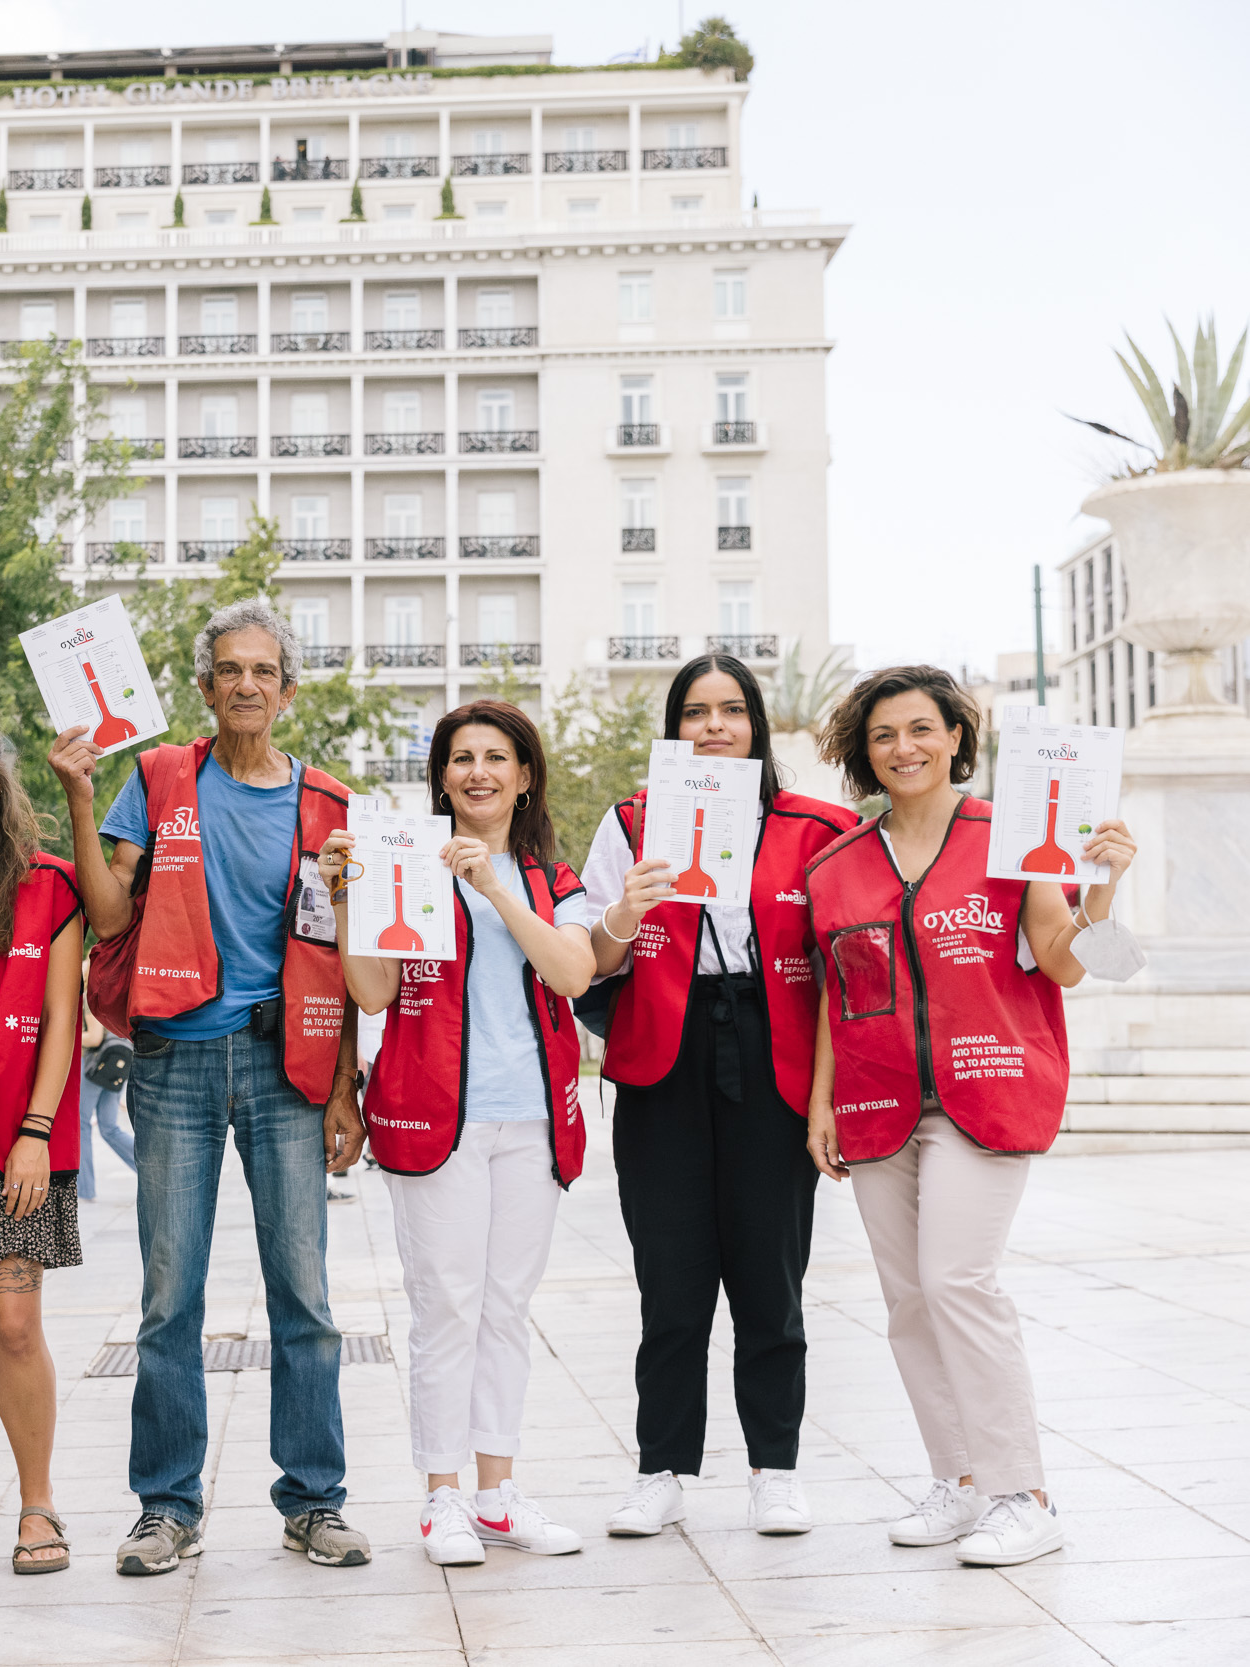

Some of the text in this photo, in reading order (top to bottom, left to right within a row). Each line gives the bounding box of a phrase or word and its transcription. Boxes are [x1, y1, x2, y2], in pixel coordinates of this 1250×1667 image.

[13, 73, 434, 108] HOTEL GRANDE BRETAGNE
[640, 924, 665, 933] HEDIA
[639, 932, 671, 943] REECE's
[932, 934, 966, 943] ΠΕΡΙΟΔΙΚΟ
[634, 941, 663, 950] STREET
[937, 940, 963, 949] ΔΡΟΜΟΥ
[634, 950, 657, 959] PAPER
[138, 966, 201, 979] ΣΤΗ ΦΤΩΧΕΙΑ
[304, 996, 341, 1006] ΠΑΡΑΚΑΛΩ,
[303, 1007, 318, 1015] ΑΠΟ
[303, 1018, 312, 1026] ΘΑ
[314, 1018, 323, 1026] ΤΟ
[303, 1029, 324, 1037] ΠΑΡΤΕ
[951, 1035, 998, 1046] ΠΑΡΑΚΑΛΩ,
[952, 1048, 970, 1057] ΑΠΟ
[971, 1047, 983, 1055] ΤΗ
[984, 1046, 1011, 1055] ΣΤΙΓΜΗ
[953, 1057, 1025, 1069] ΘΑ ΤΟ ΑΓΟΡΑΣΕΤΕ,
[955, 1068, 1024, 1080] ΠΑΡΤΕ ΤΟ ΤΕΥΧΟΣ
[842, 1104, 858, 1114] ΣΤΗ
[859, 1098, 899, 1111] ΦΤΩΧΕΙΑ
[390, 1120, 431, 1130] ΦΤΩΧΕΙΑ
